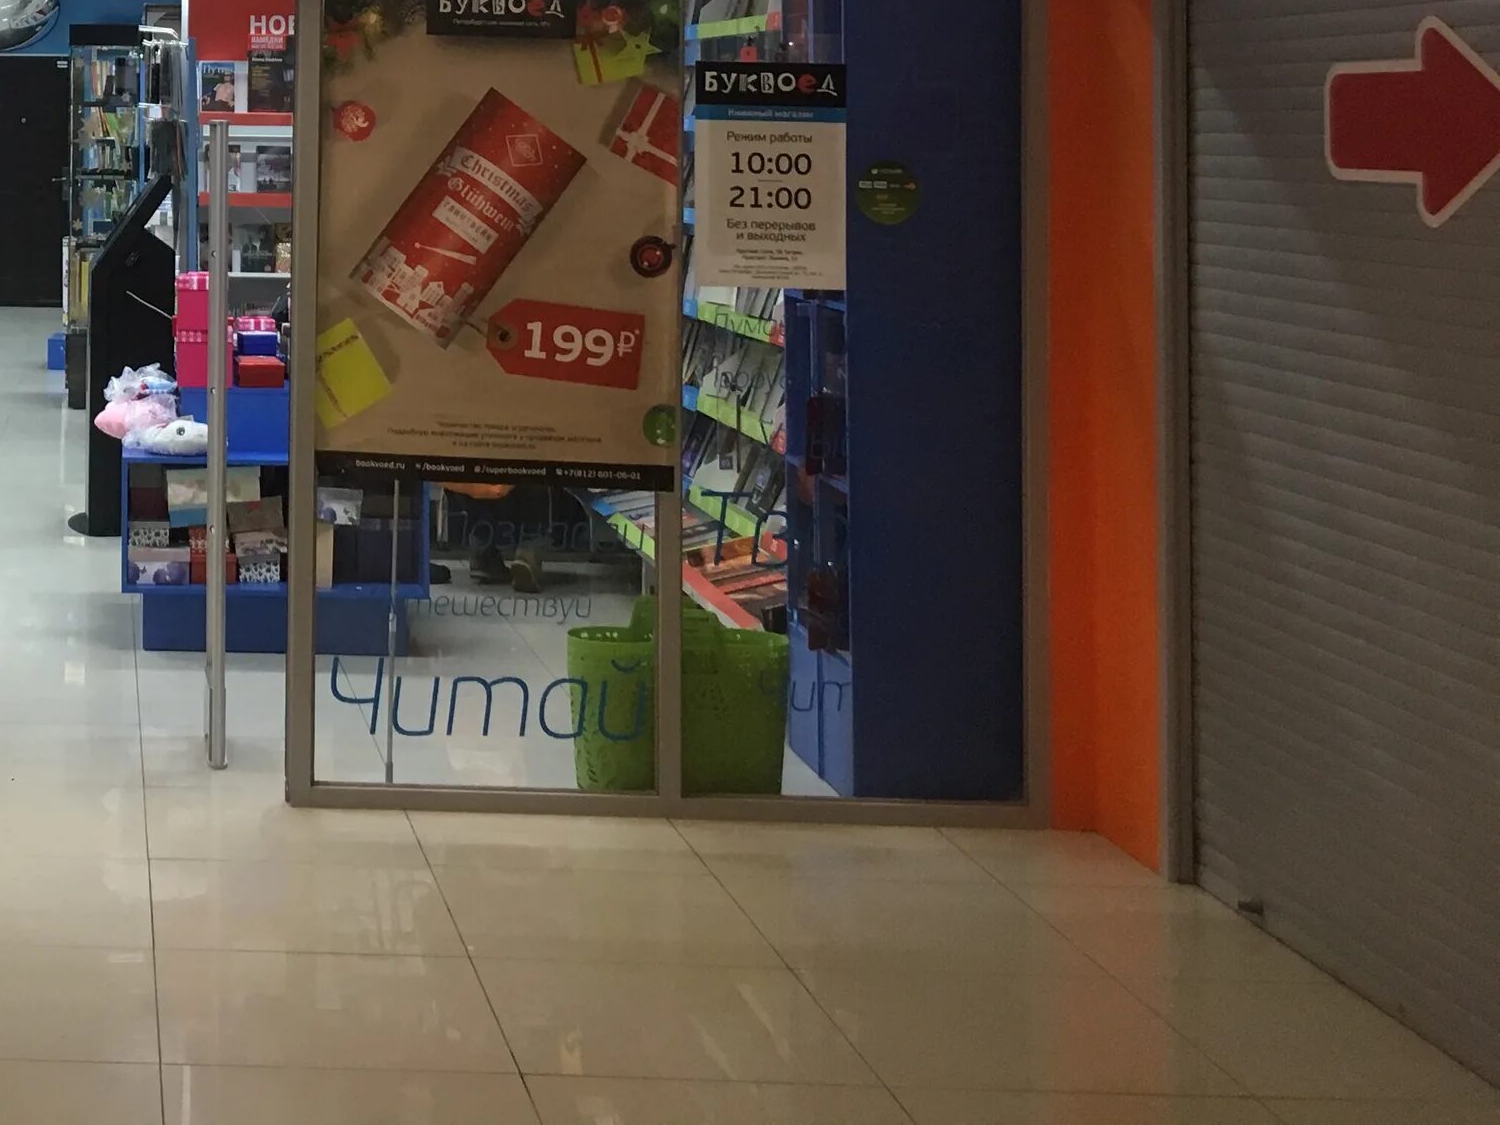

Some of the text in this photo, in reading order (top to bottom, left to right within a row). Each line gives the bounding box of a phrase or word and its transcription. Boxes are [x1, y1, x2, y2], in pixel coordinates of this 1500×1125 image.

[726, 130, 813, 144] Режим работы
[730, 151, 813, 176] 10:00
[460, 154, 534, 212] Christmas
[729, 185, 812, 210] 21:00
[726, 218, 816, 233] Без перерывов
[736, 231, 807, 243] и выходных
[329, 656, 648, 741] Читай
